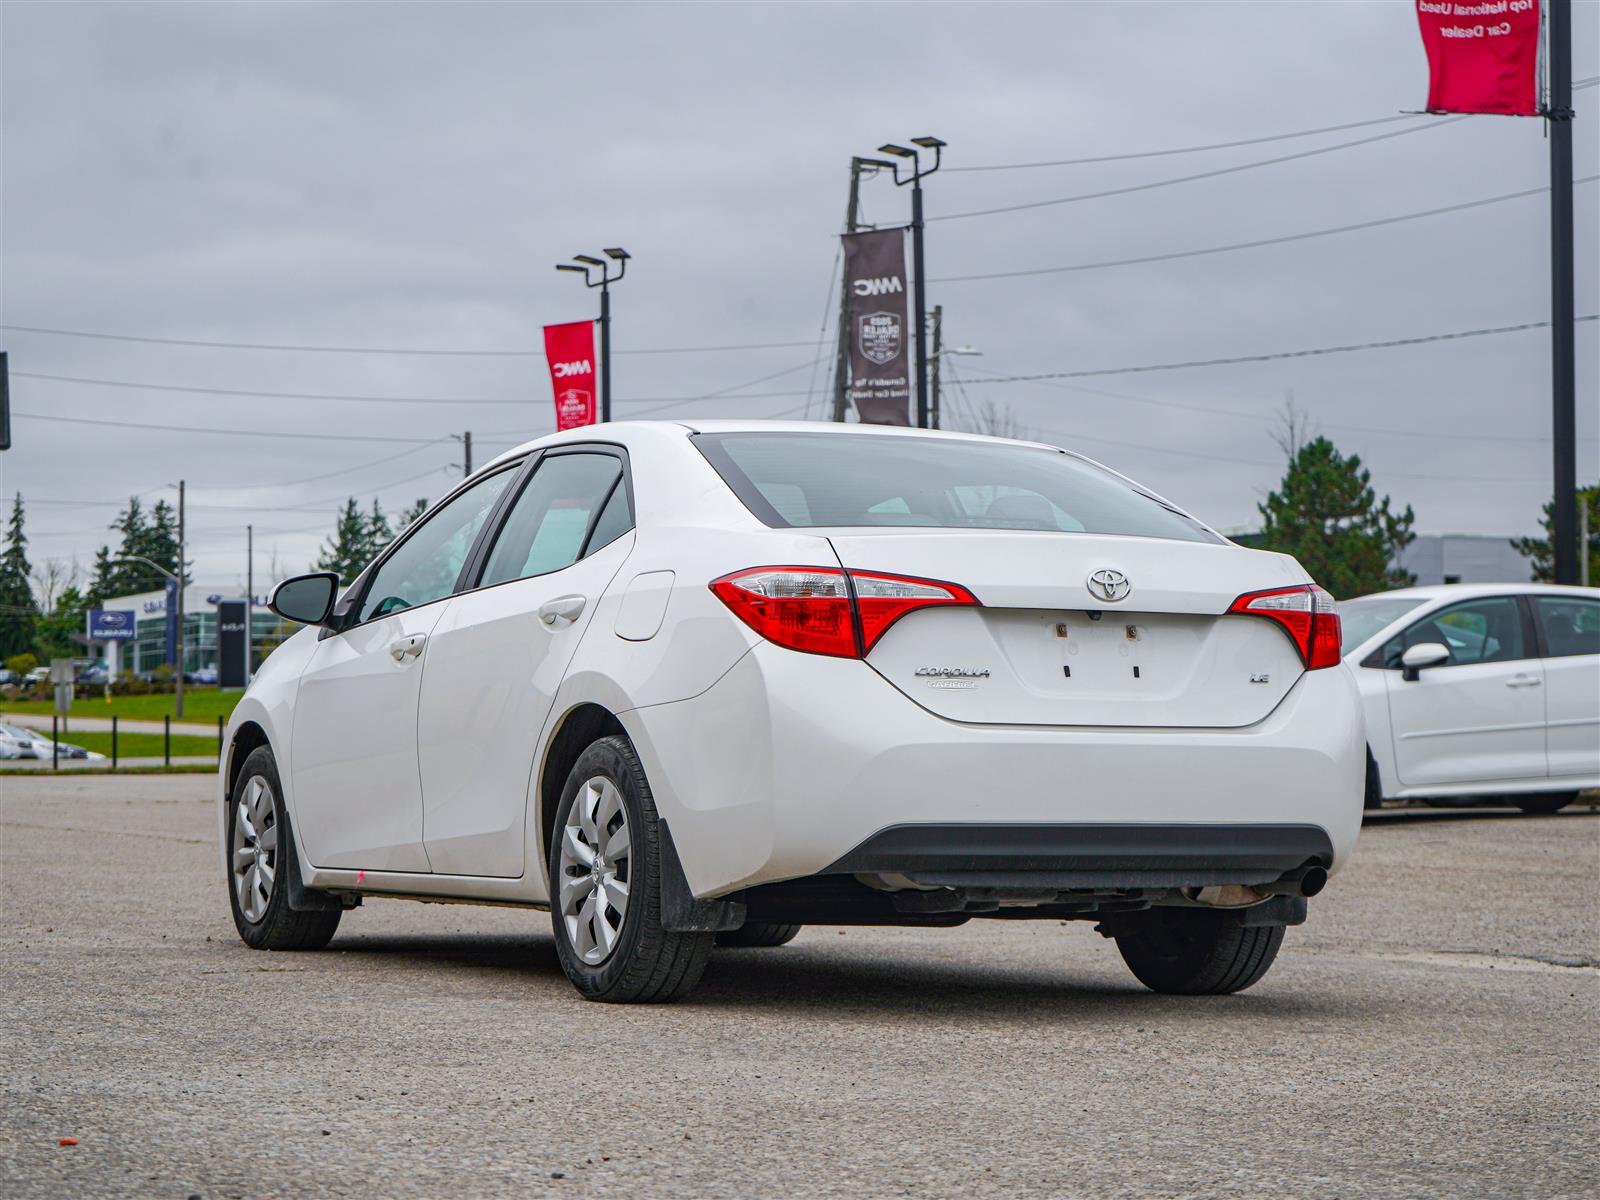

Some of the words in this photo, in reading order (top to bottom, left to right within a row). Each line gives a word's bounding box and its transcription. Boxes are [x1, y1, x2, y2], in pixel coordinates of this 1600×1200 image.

[93, 629, 133, 638] SUBARU
[915, 667, 990, 678] COROLLA
[1249, 674, 1270, 684] LE
